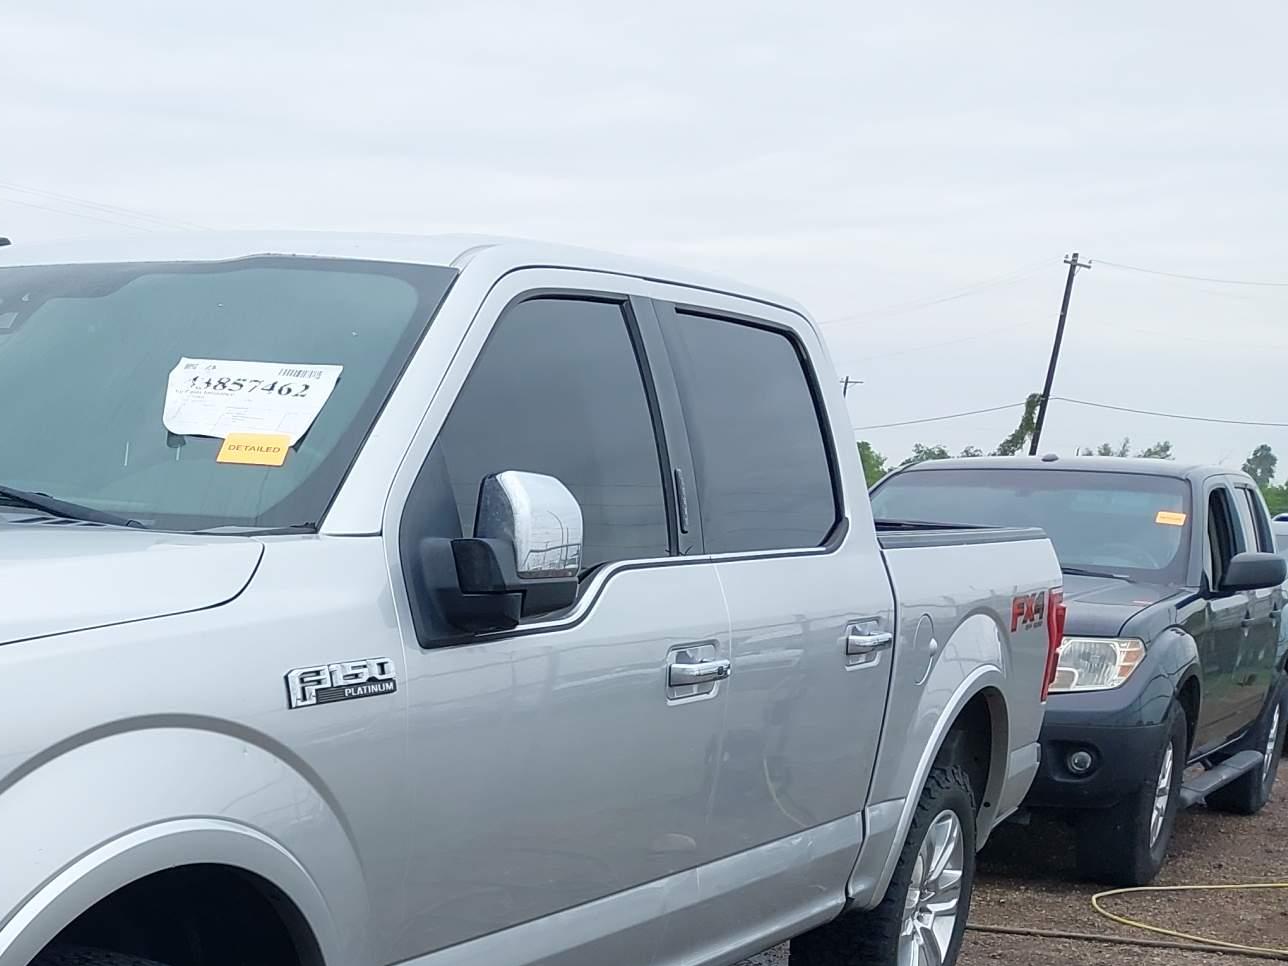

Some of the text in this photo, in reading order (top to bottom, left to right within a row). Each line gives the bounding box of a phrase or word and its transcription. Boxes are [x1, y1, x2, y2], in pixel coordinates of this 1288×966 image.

[226, 444, 281, 454] DETAILED
[1011, 591, 1045, 633] FX4
[344, 682, 394, 697] PLATINUM
